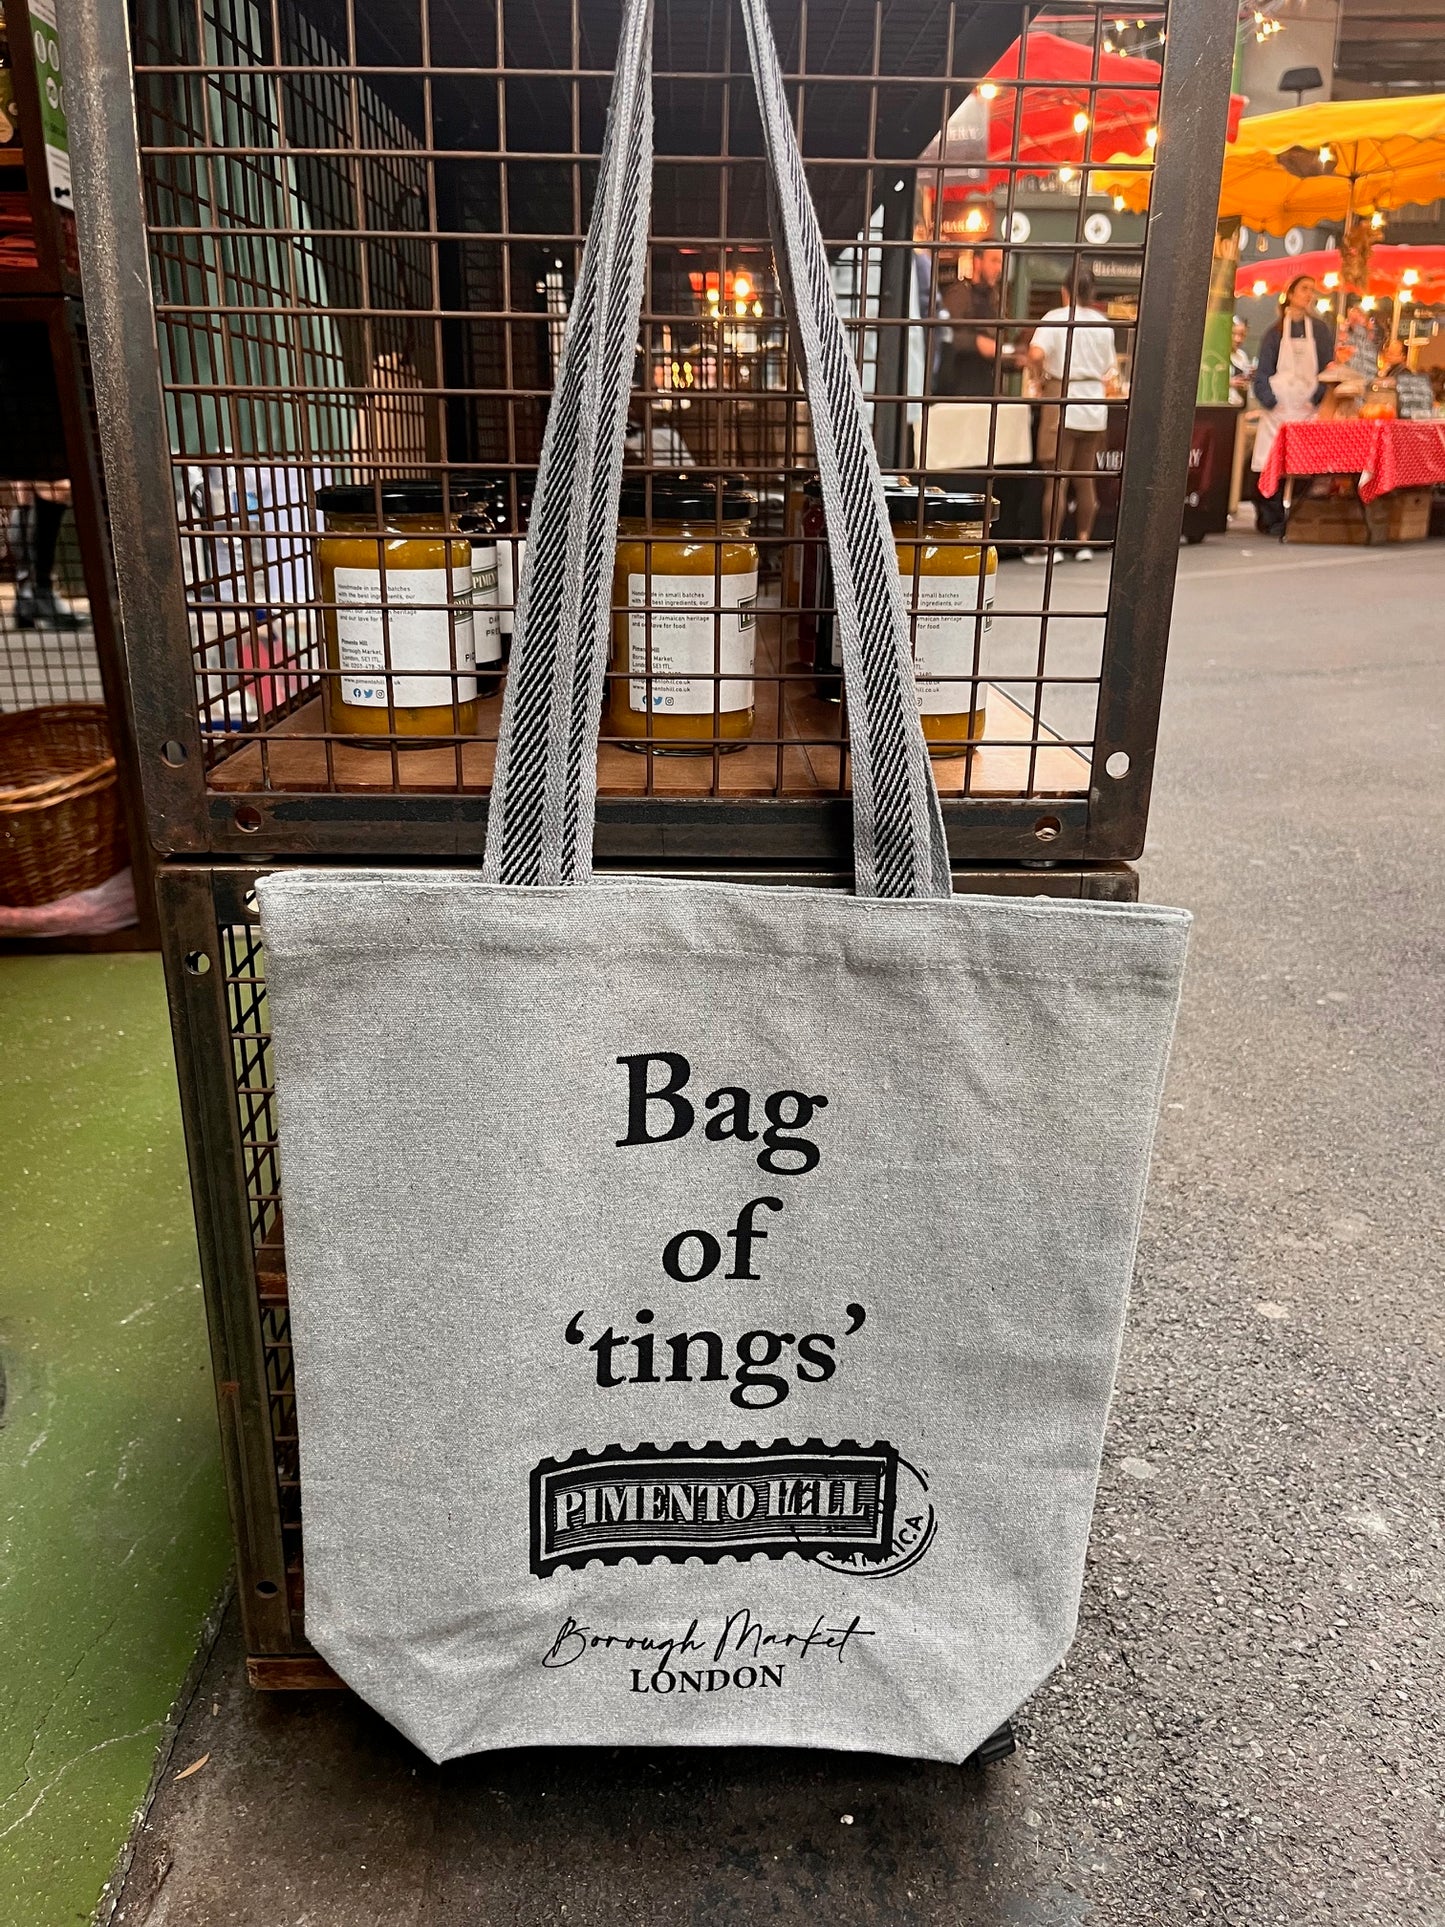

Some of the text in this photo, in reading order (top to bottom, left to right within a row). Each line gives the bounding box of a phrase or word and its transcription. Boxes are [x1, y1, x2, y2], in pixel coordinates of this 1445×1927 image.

[616, 1052, 828, 1175] Bag
[662, 1197, 783, 1282] of
[554, 1479, 866, 1532] PIMENTO HILL
[542, 1608, 876, 1674] Borough Market
[629, 1669, 784, 1694] LONDON
